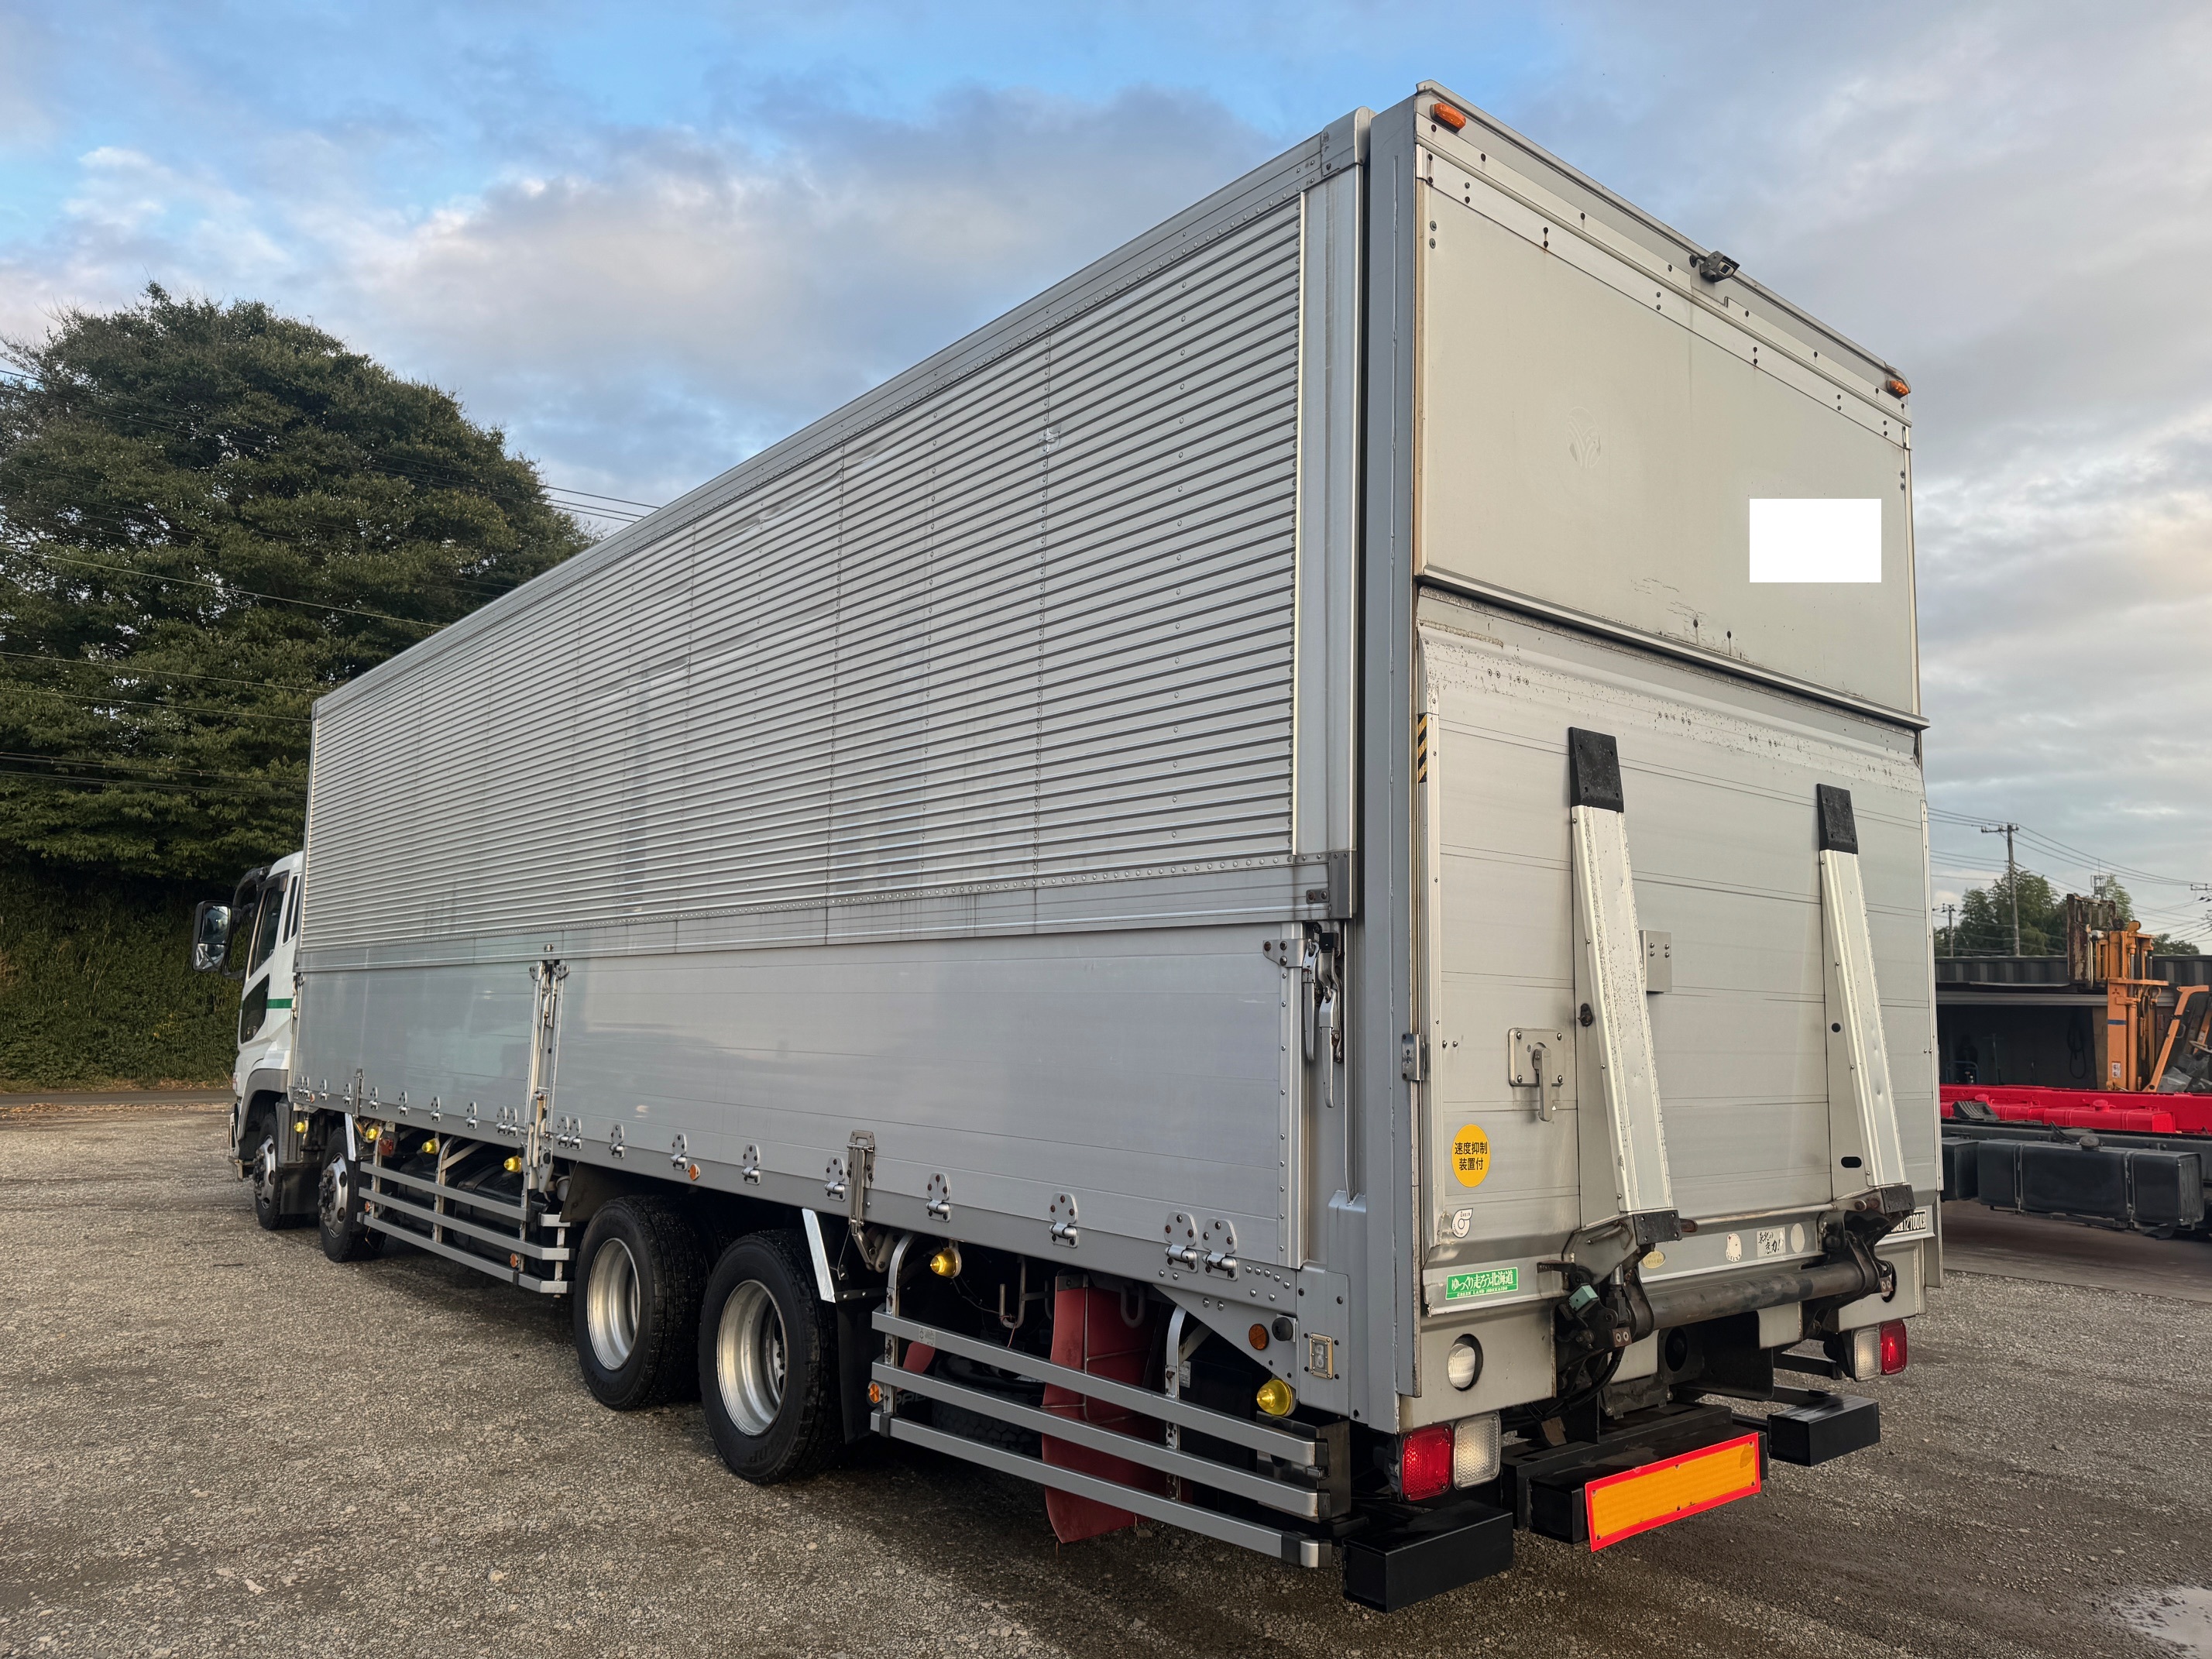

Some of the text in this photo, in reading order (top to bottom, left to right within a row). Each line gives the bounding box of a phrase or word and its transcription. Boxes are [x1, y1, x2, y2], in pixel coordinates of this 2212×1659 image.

[1455, 1142, 1488, 1155] 速度抑制
[1459, 1157, 1484, 1171] 装置付
[1451, 1269, 1513, 1291] ゆっくり走ろう北海道
